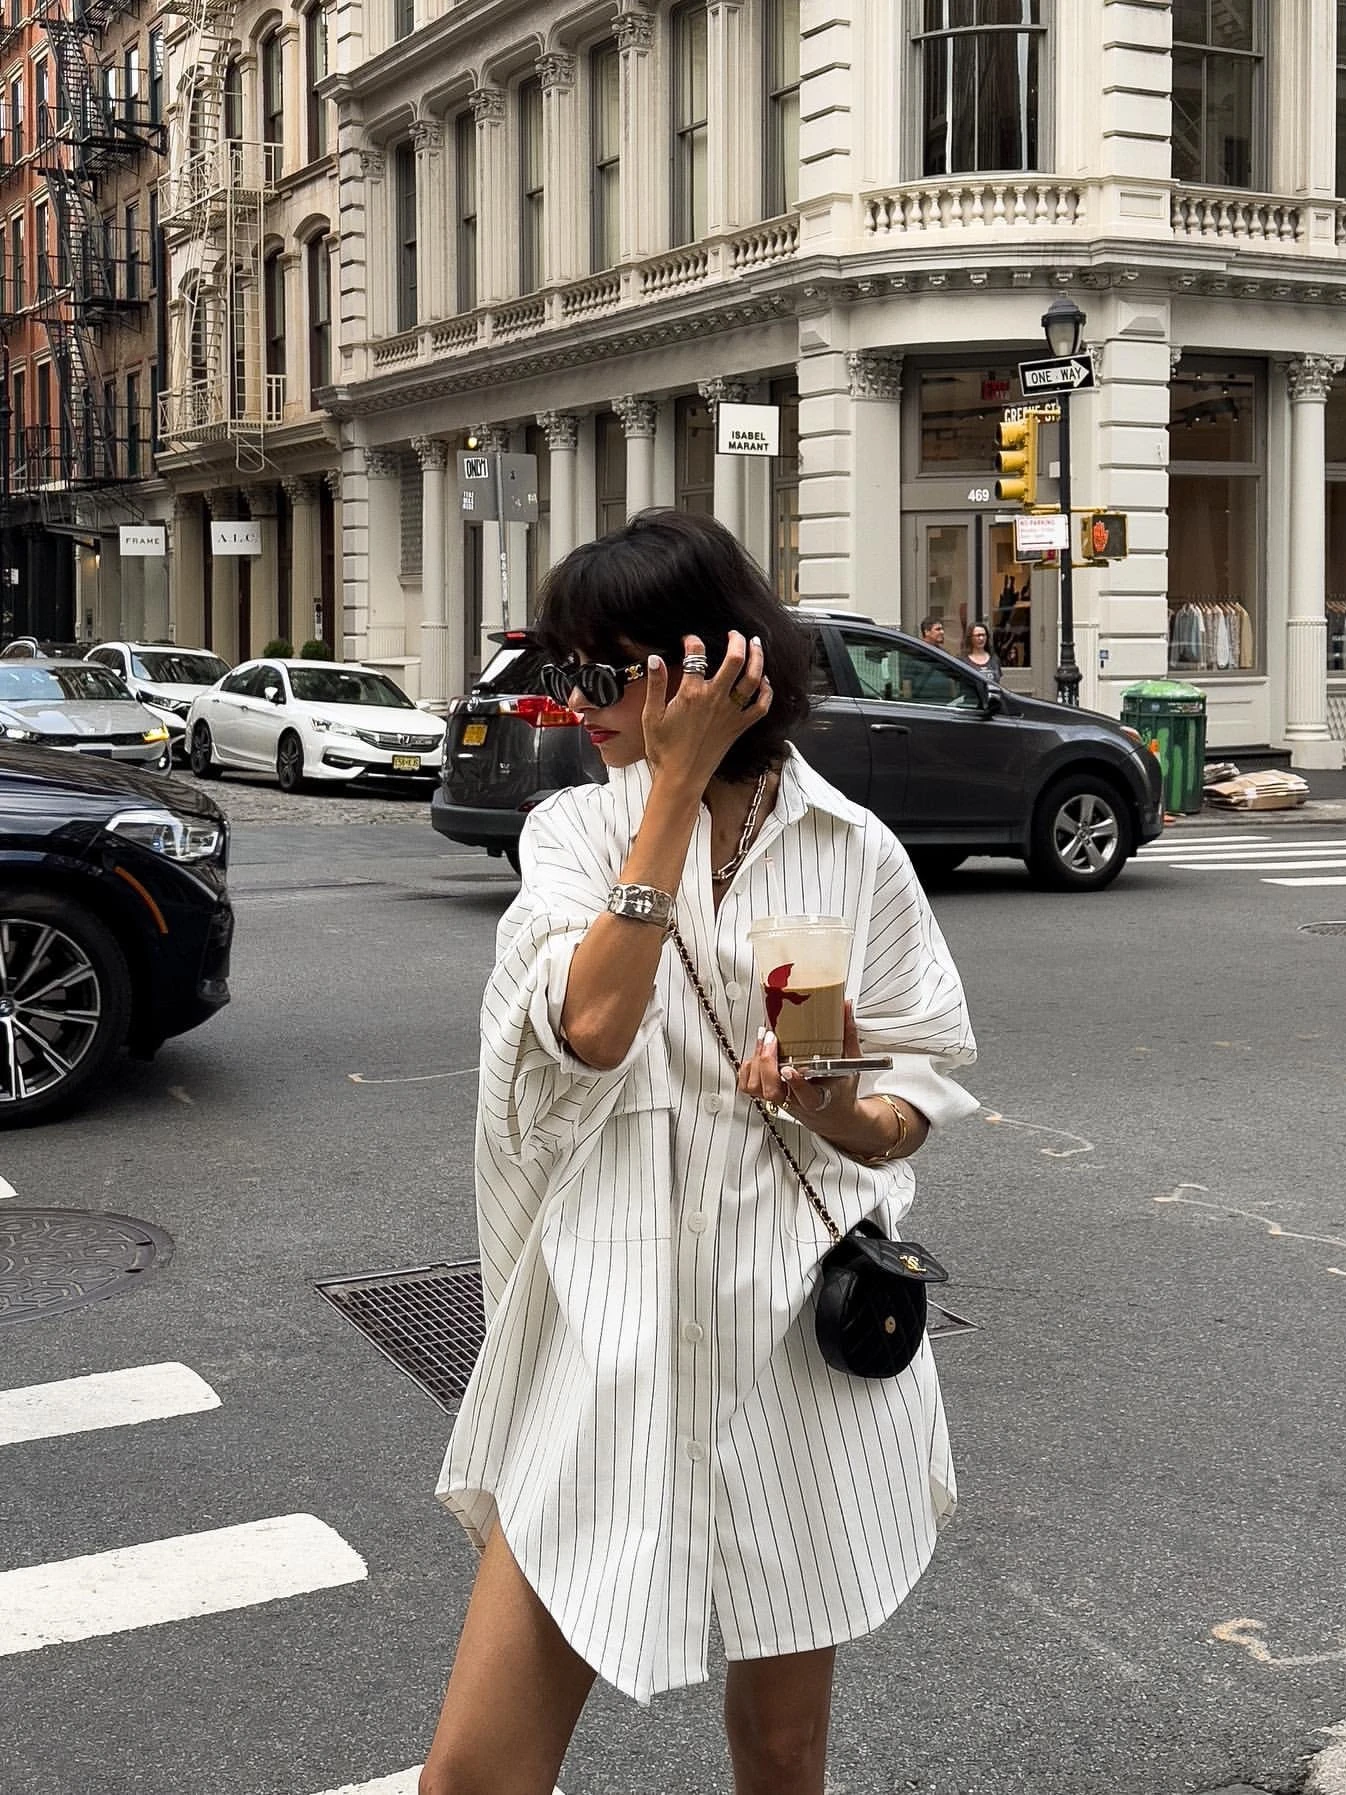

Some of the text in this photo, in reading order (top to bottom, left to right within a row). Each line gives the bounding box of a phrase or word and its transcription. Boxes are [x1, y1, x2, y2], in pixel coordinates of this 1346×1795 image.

[1031, 365, 1084, 384] ONE WAY
[731, 430, 766, 440] ISABEL
[728, 441, 769, 451] MARANT
[968, 489, 989, 502] 469
[125, 537, 160, 545] FRAME
